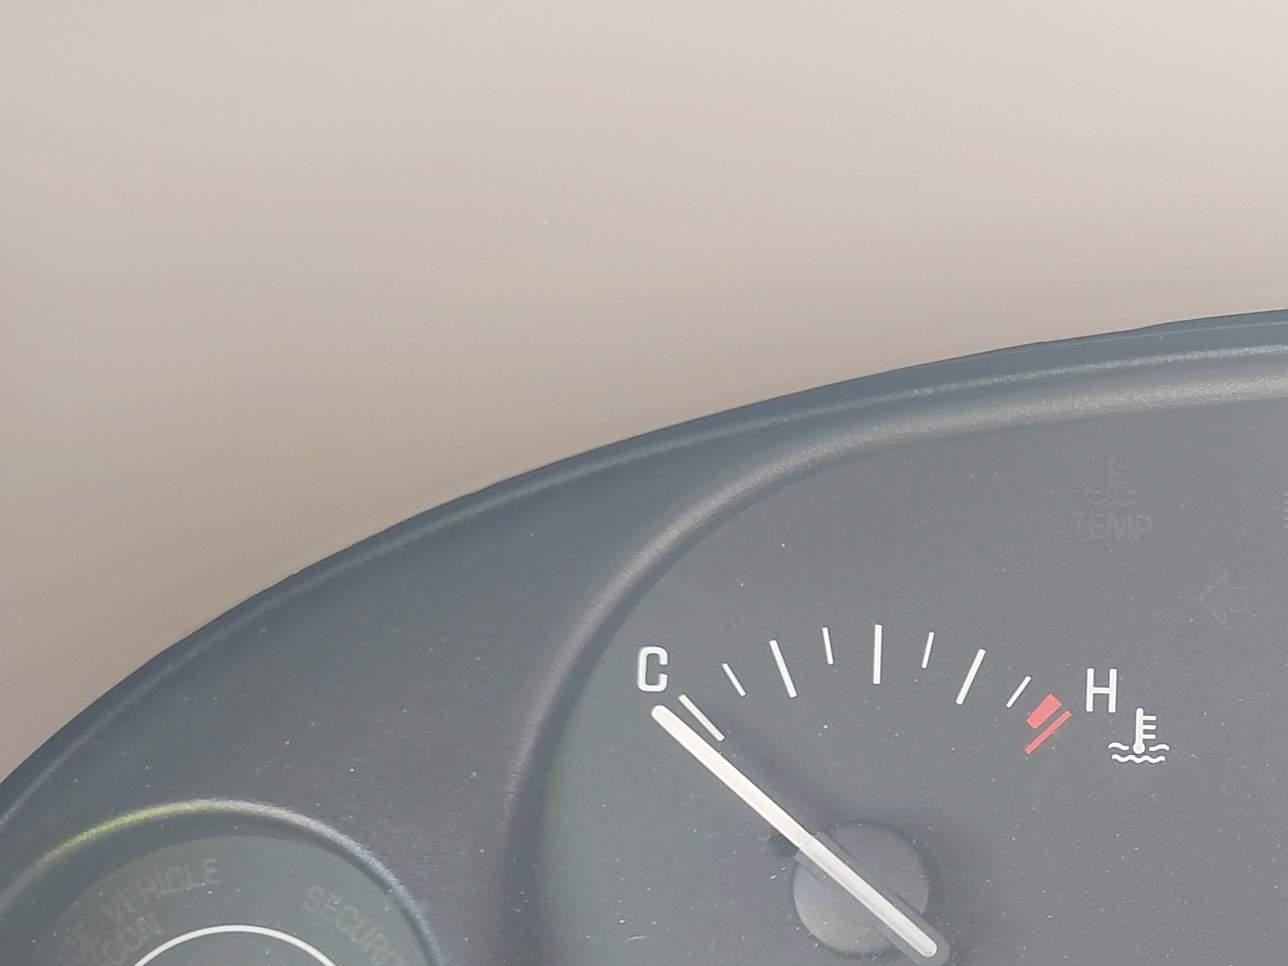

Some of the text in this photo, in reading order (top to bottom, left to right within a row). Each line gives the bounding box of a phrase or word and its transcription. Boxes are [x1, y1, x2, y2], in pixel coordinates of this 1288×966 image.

[1071, 510, 1153, 542] TEMP
[637, 646, 668, 692] C
[1085, 668, 1118, 713] H
